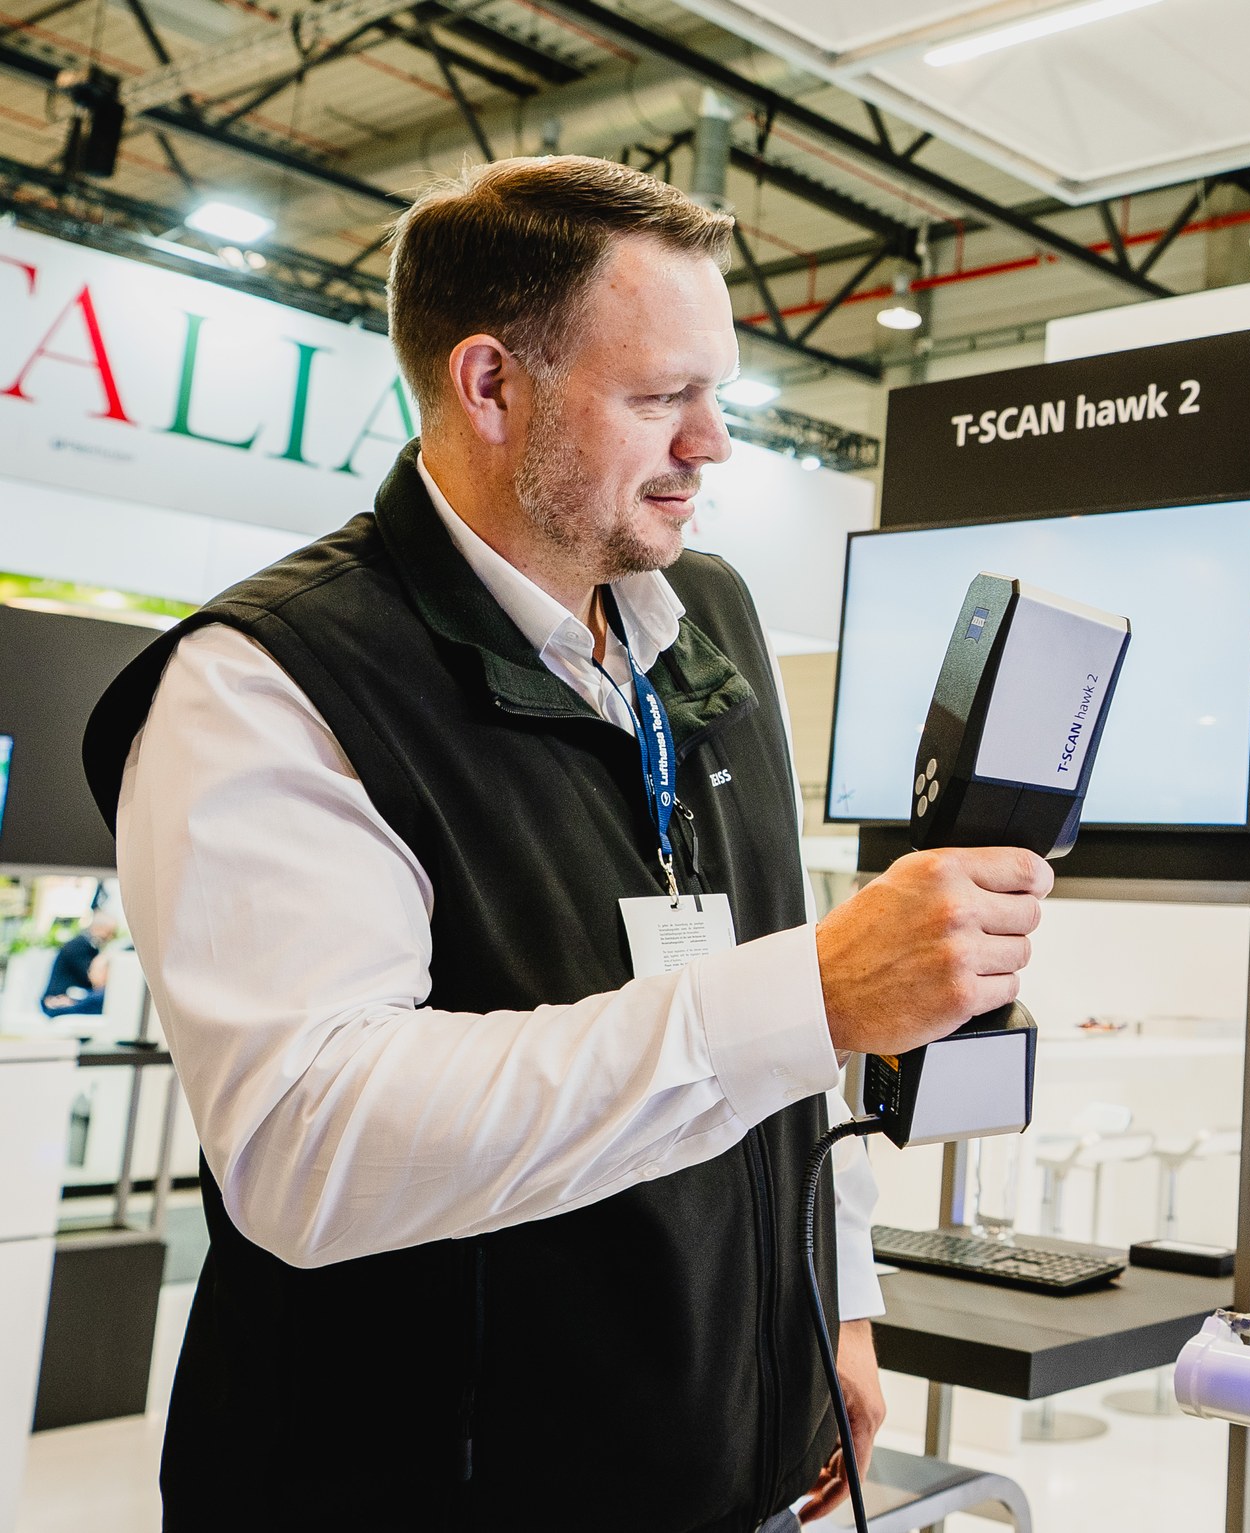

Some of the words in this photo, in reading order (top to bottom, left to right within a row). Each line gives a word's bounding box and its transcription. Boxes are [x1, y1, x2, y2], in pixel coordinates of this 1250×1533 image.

[951, 400, 1065, 447] T-SCAN
[1075, 383, 1168, 430] hawk
[1178, 379, 1200, 415] 2
[646, 694, 663, 732] Technik
[1057, 722, 1082, 773] T-SCAN
[1074, 686, 1095, 720] hawk
[1087, 673, 1098, 683] 2
[656, 732, 669, 786] Lufthansa
